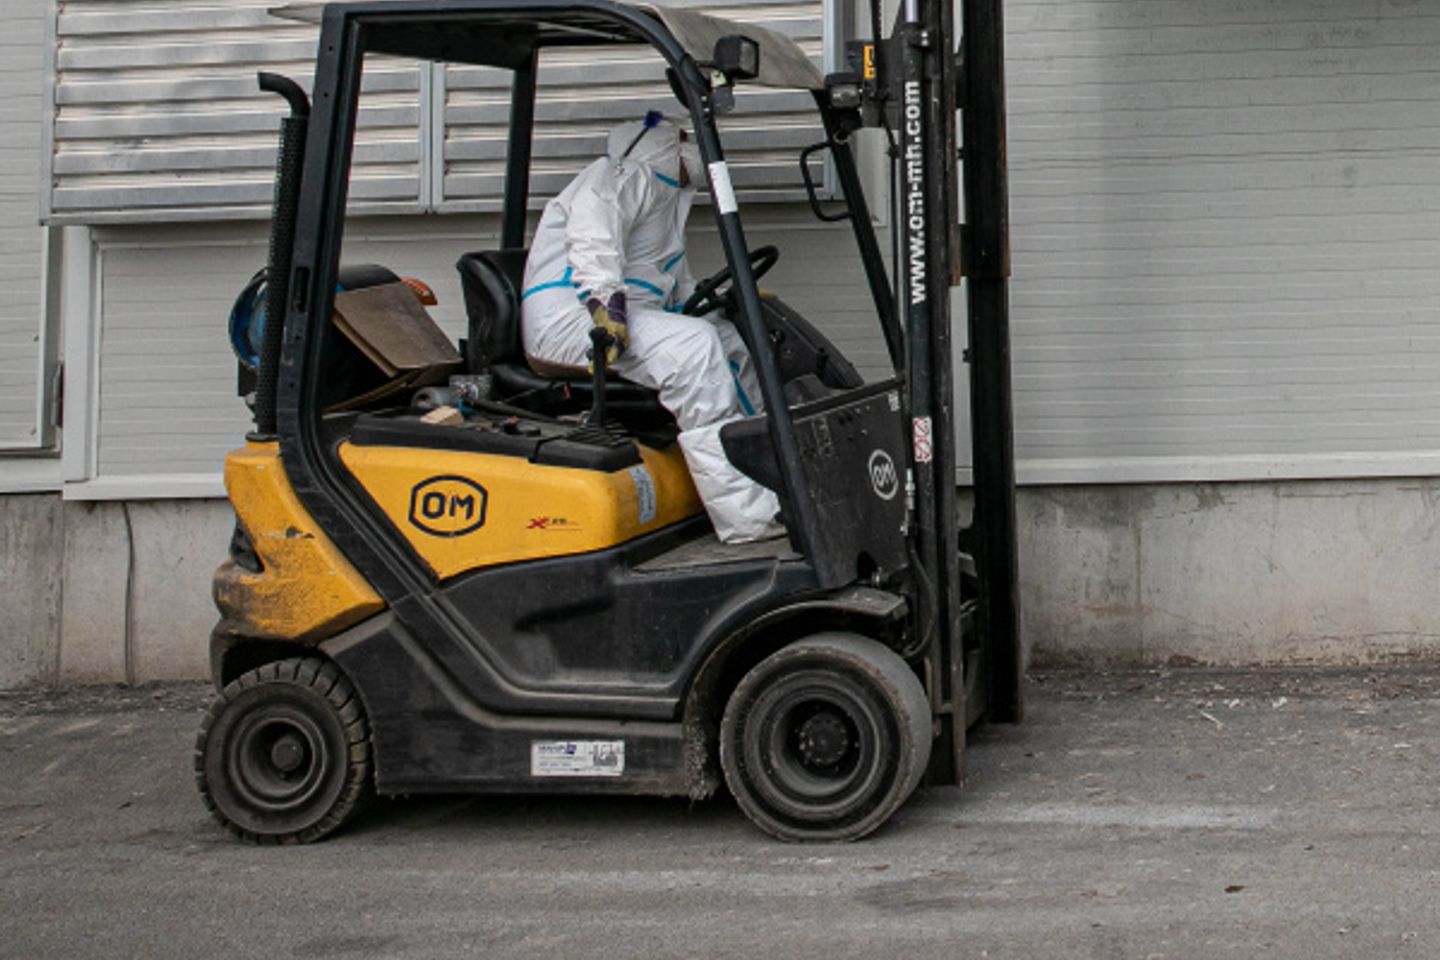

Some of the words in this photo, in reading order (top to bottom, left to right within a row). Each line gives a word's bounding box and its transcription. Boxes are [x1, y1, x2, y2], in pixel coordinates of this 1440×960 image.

[905, 81, 925, 304] www.om-mh.com
[872, 463, 897, 487] OM
[423, 492, 475, 520] OM
